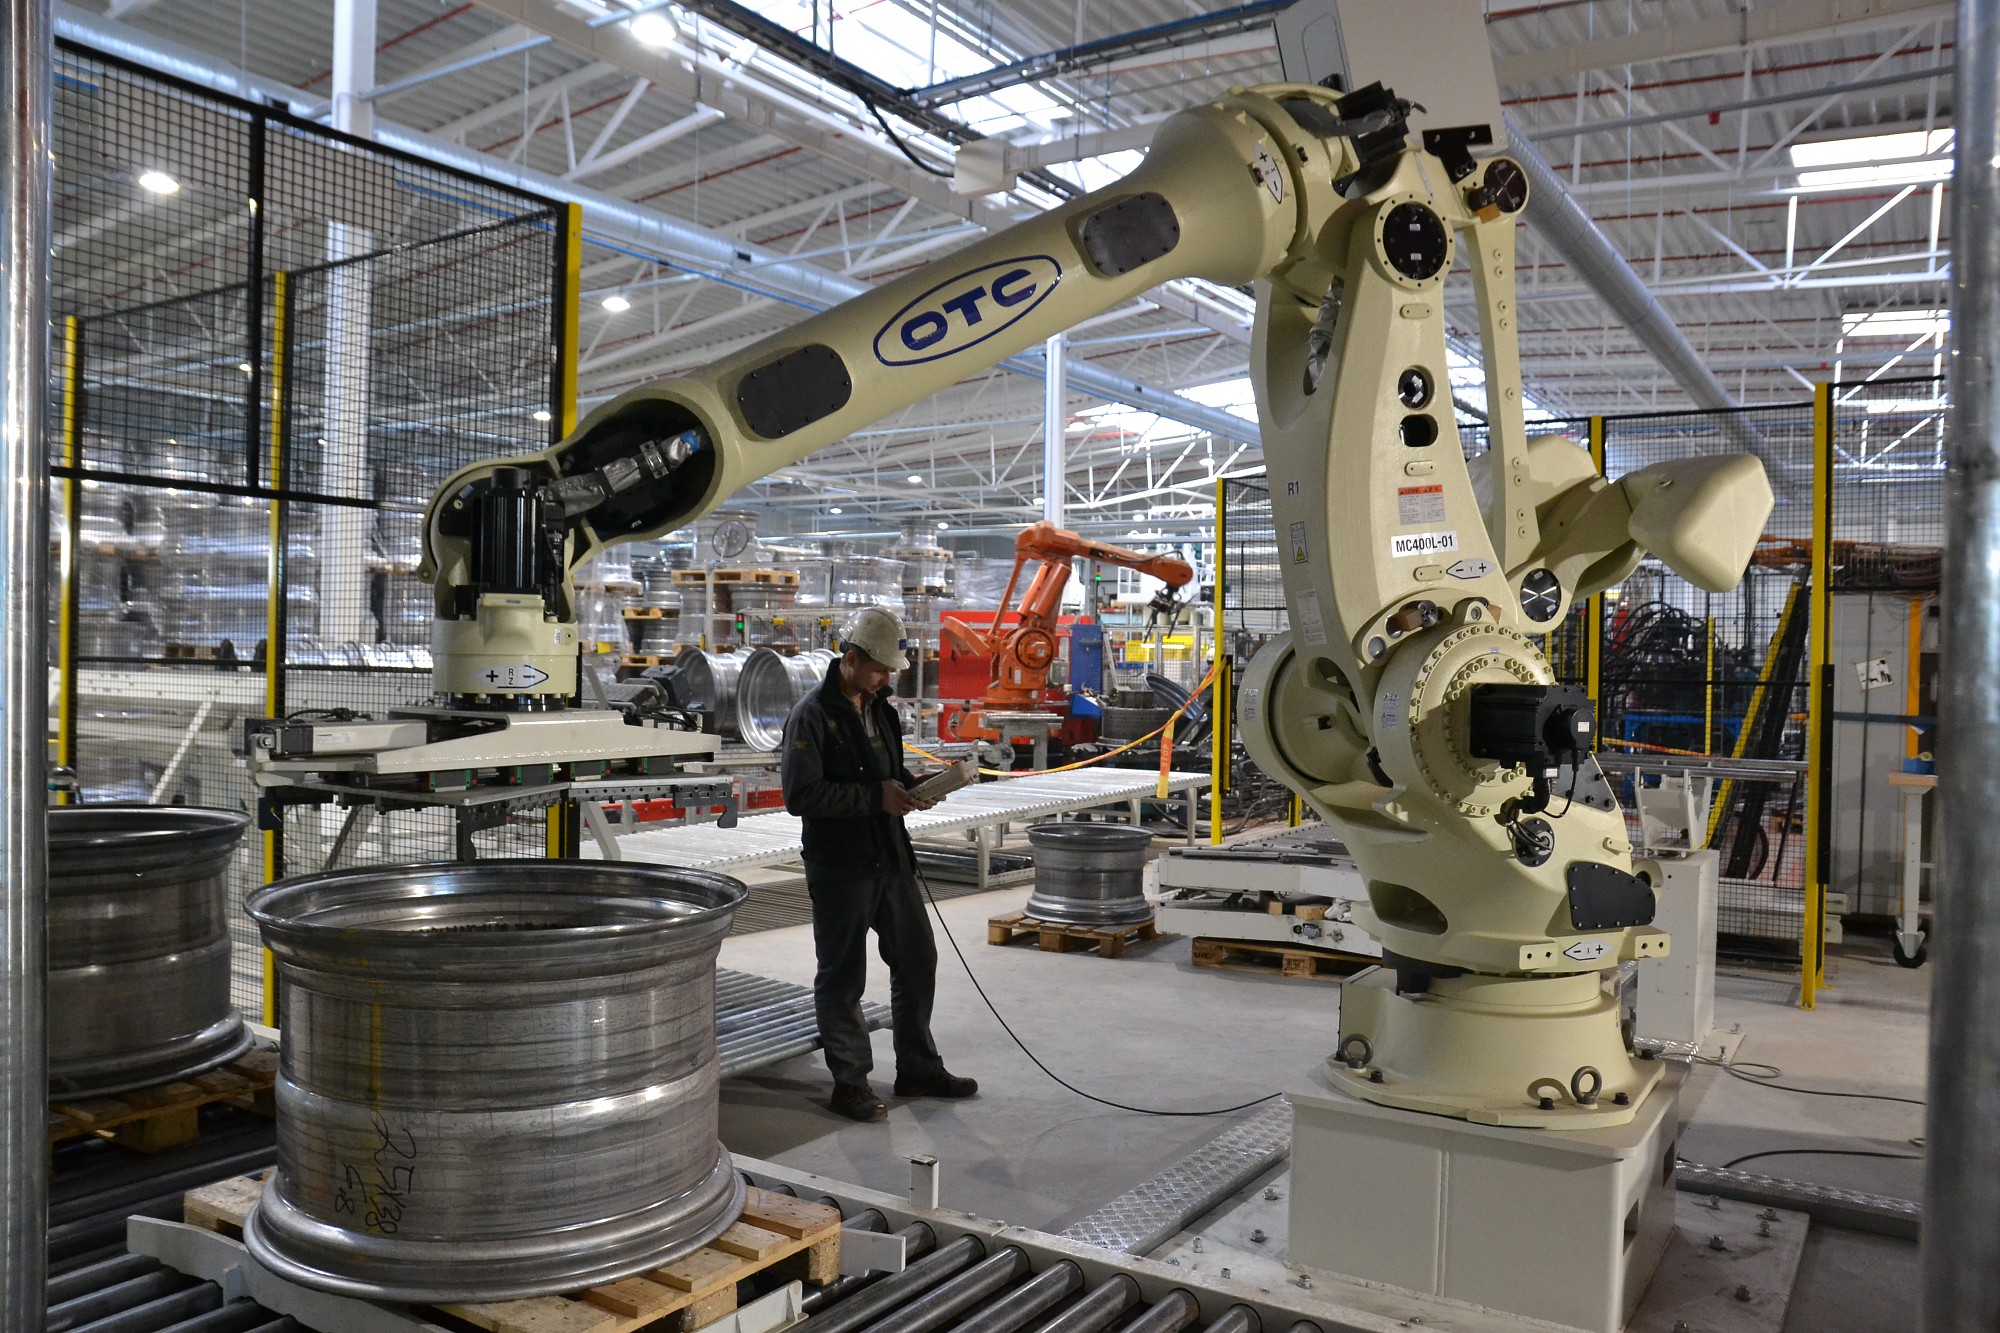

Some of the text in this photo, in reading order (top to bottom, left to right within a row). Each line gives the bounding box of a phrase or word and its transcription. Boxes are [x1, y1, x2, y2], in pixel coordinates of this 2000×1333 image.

[900, 268, 1037, 351] OTC
[1288, 481, 1300, 497] R1
[1396, 535, 1454, 552] MC400L-01
